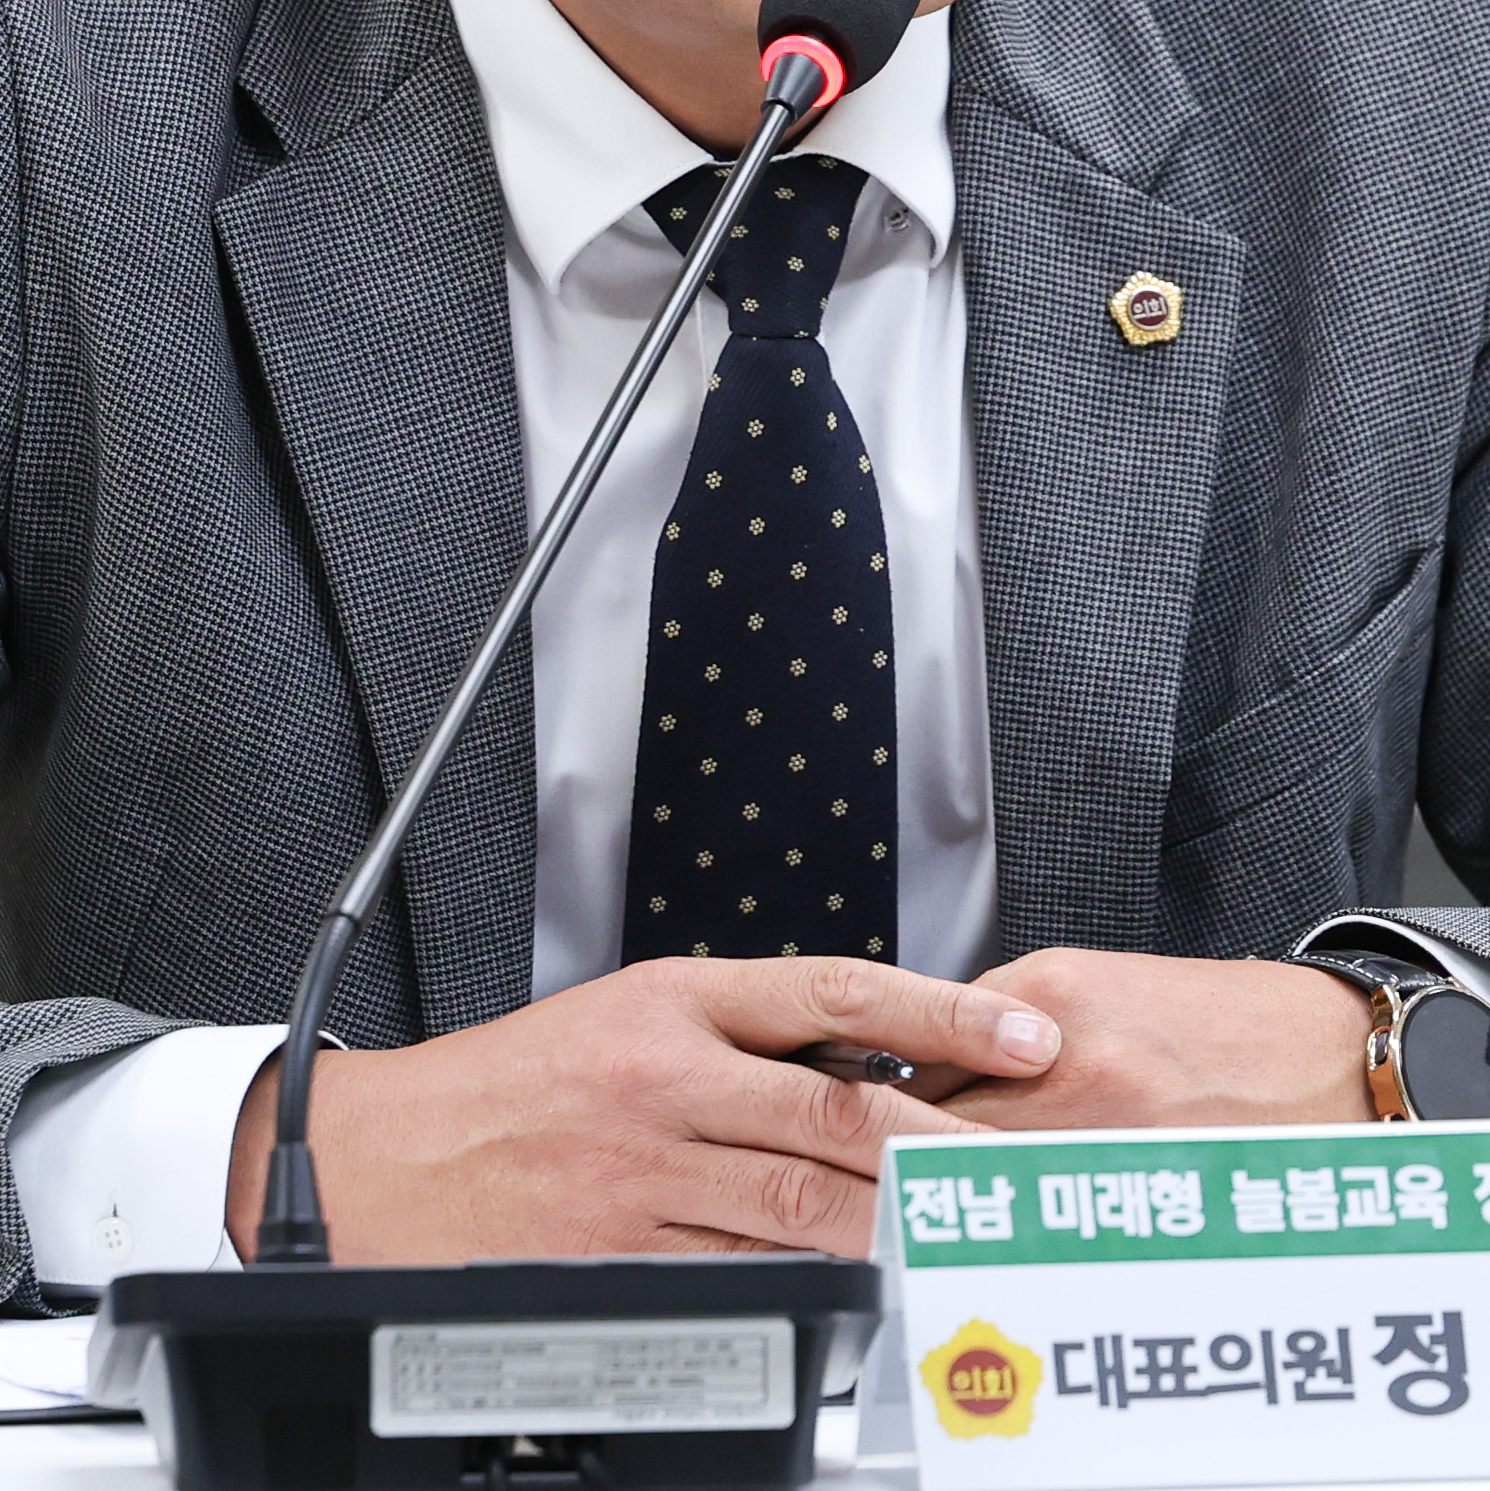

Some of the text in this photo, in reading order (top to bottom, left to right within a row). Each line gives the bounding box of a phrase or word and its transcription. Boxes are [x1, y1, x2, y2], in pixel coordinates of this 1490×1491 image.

[902, 1177, 1015, 1242] 전남
[1038, 1171, 1206, 1240] 미래형
[1230, 1166, 1448, 1232] 늘봄교육
[952, 1365, 1013, 1399] 의회
[1052, 1328, 1355, 1408] 대표의원
[1373, 1311, 1470, 1415] 정
